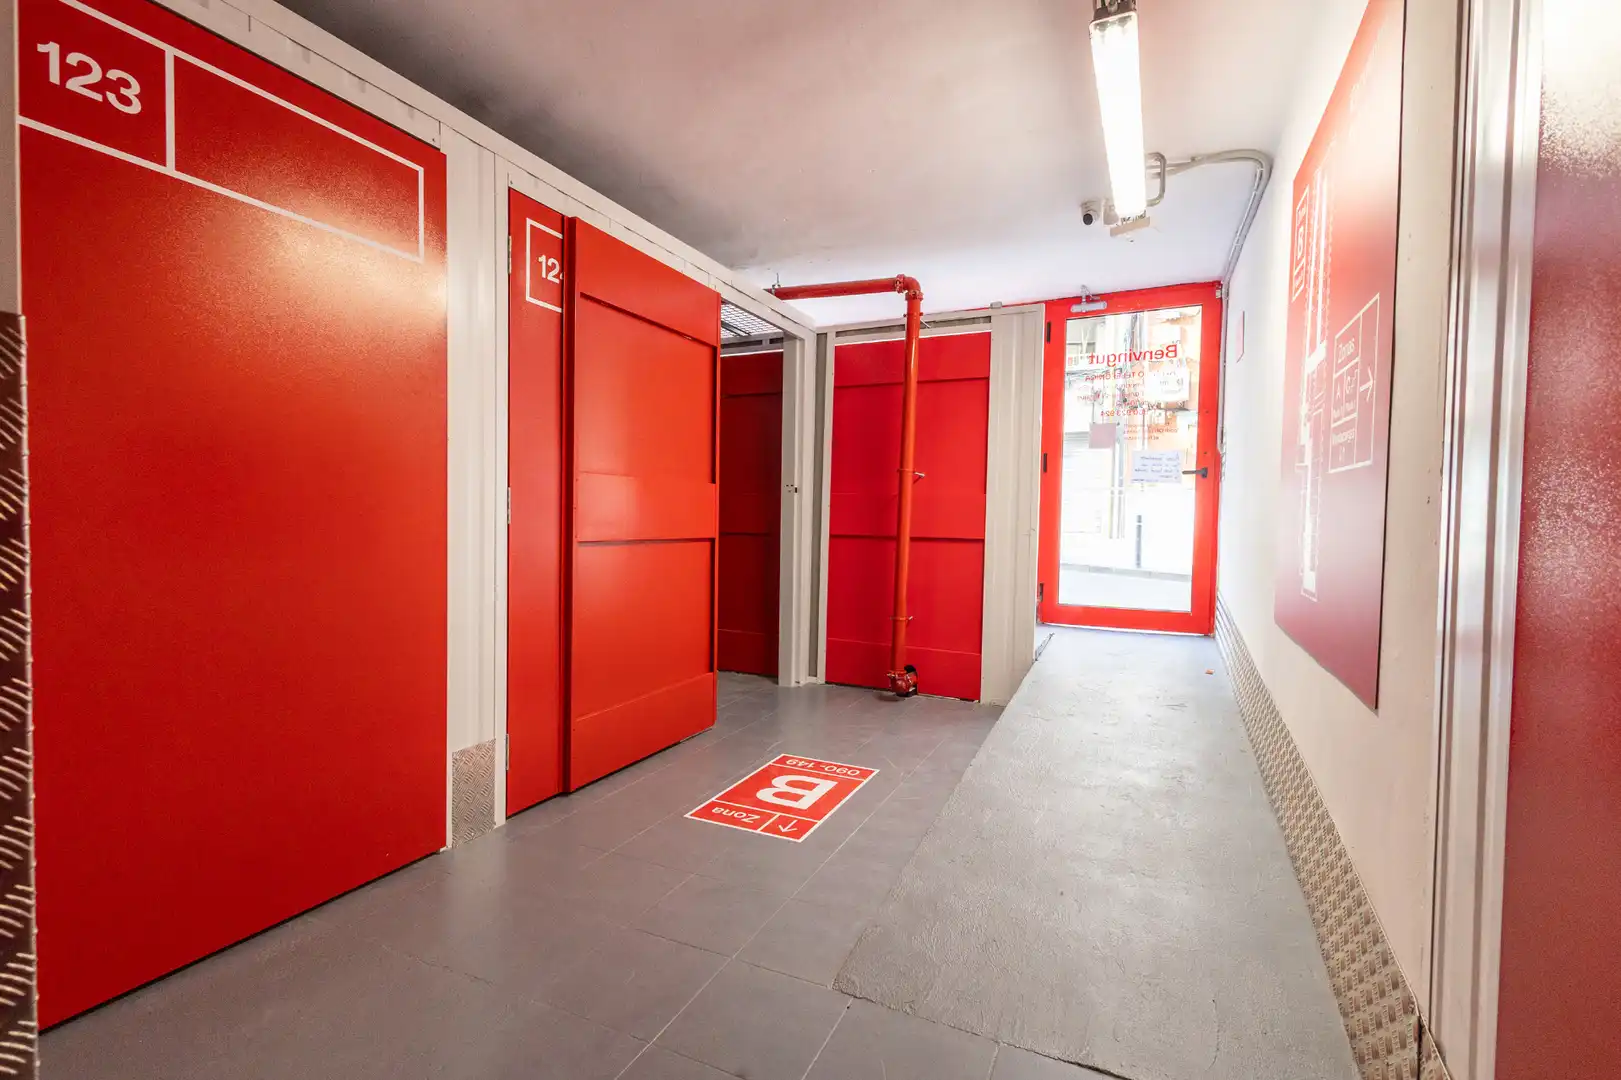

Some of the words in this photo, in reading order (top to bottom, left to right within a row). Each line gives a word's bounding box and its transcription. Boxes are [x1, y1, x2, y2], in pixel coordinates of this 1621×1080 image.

[37, 41, 142, 114] 123
[537, 254, 564, 284] 12
[756, 775, 838, 810] B
[711, 806, 761, 824] Zona
